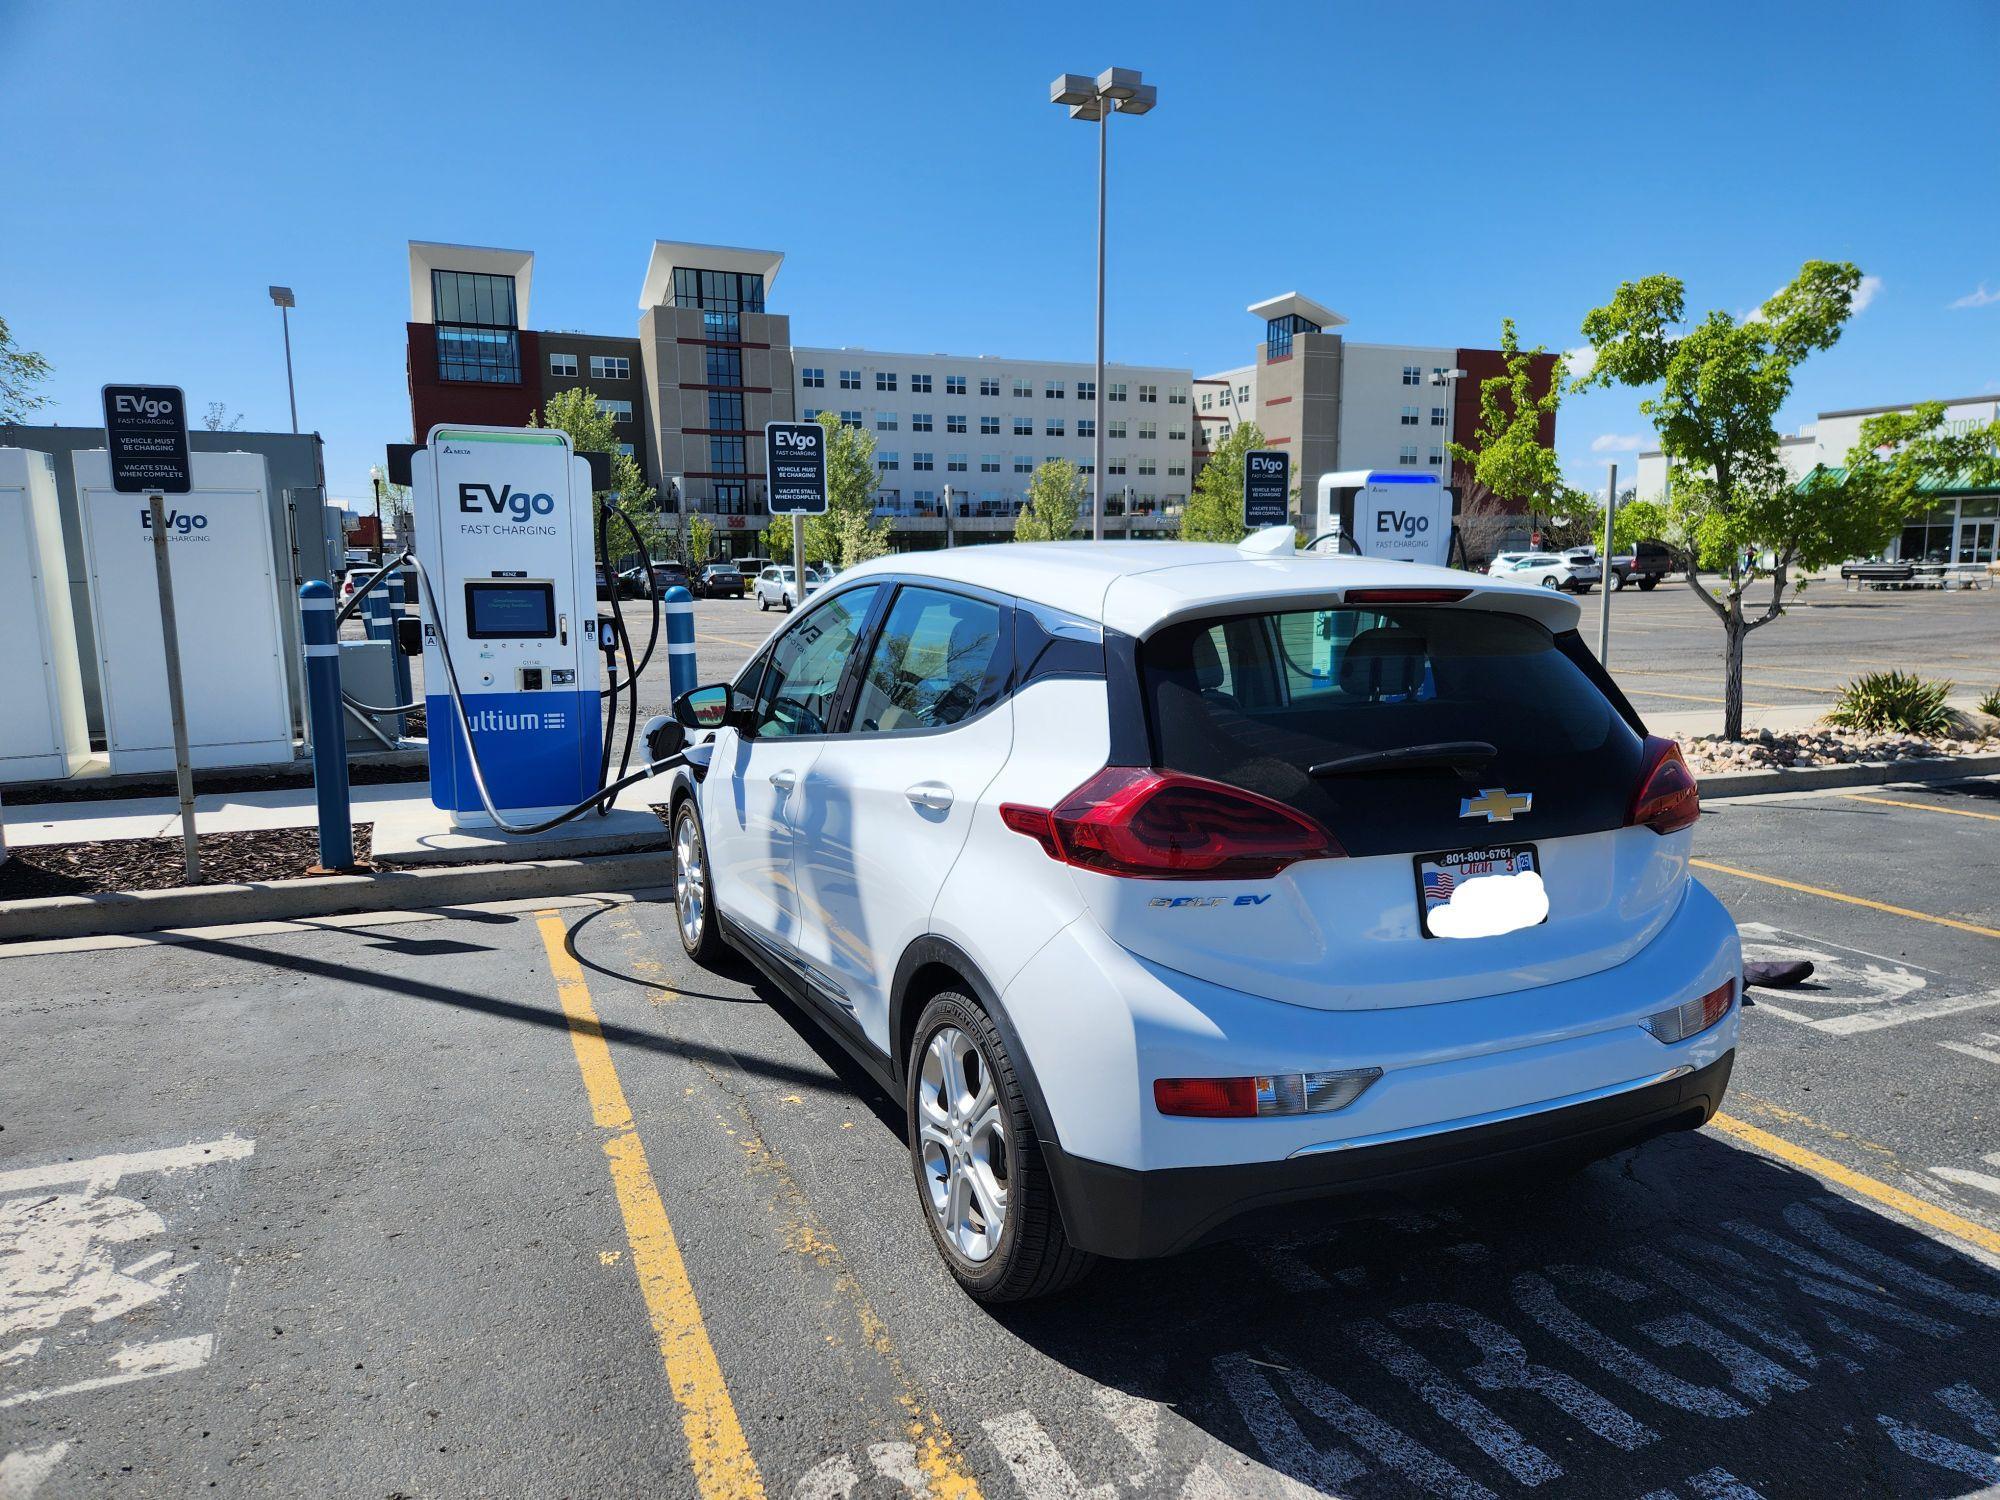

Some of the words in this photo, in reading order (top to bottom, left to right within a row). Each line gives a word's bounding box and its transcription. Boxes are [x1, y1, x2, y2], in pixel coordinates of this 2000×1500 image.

[115, 395, 173, 418] EVgo
[775, 432, 816, 450] EVgo
[1251, 457, 1283, 474] EVgo
[458, 483, 555, 523] EVgo
[460, 524, 491, 535] FAST
[493, 525, 557, 536] CHARGING
[1376, 510, 1429, 539] EVgo
[168, 535, 210, 543] CHARGING
[1375, 540, 1392, 549] FAST
[1393, 540, 1429, 549] CHARGING
[467, 710, 540, 732] ultium
[1446, 847, 1512, 865] 801-800-6761
[1460, 860, 1493, 876] Utah
[1148, 896, 1229, 908] BOLT
[1233, 893, 1272, 906] EV
